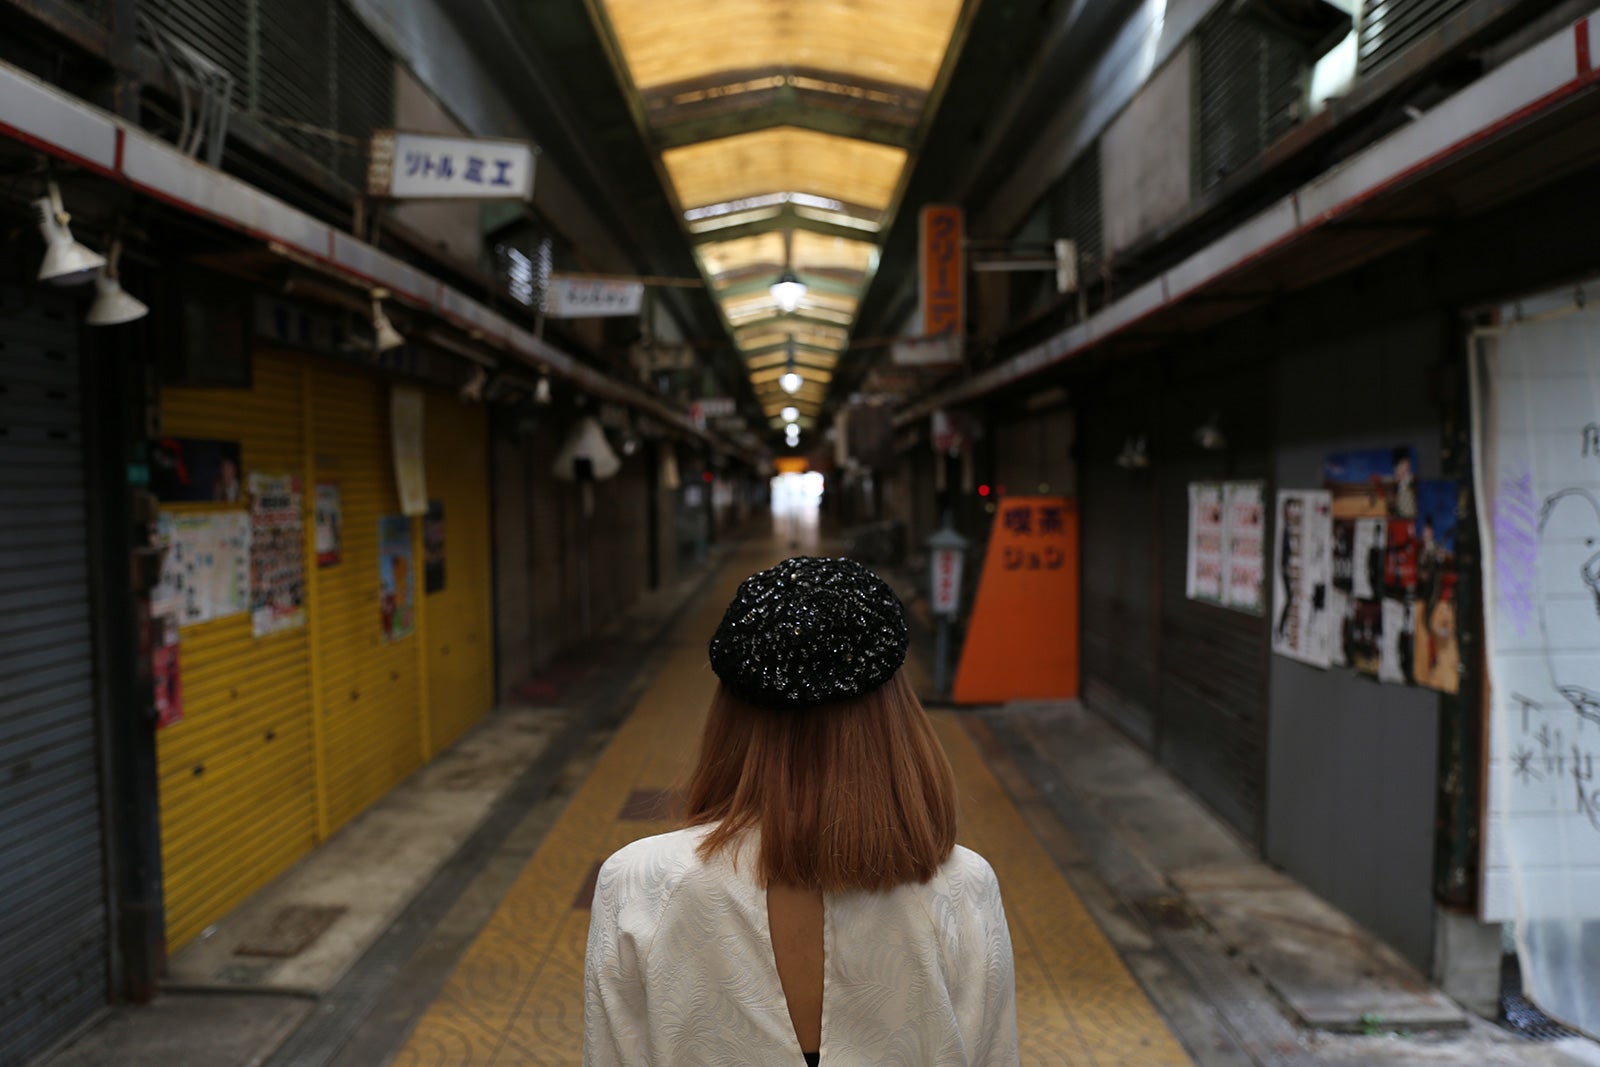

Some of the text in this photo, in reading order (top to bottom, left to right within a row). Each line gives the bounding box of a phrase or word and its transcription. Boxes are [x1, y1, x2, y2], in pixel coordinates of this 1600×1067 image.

[930, 213, 956, 334] クリーニン
